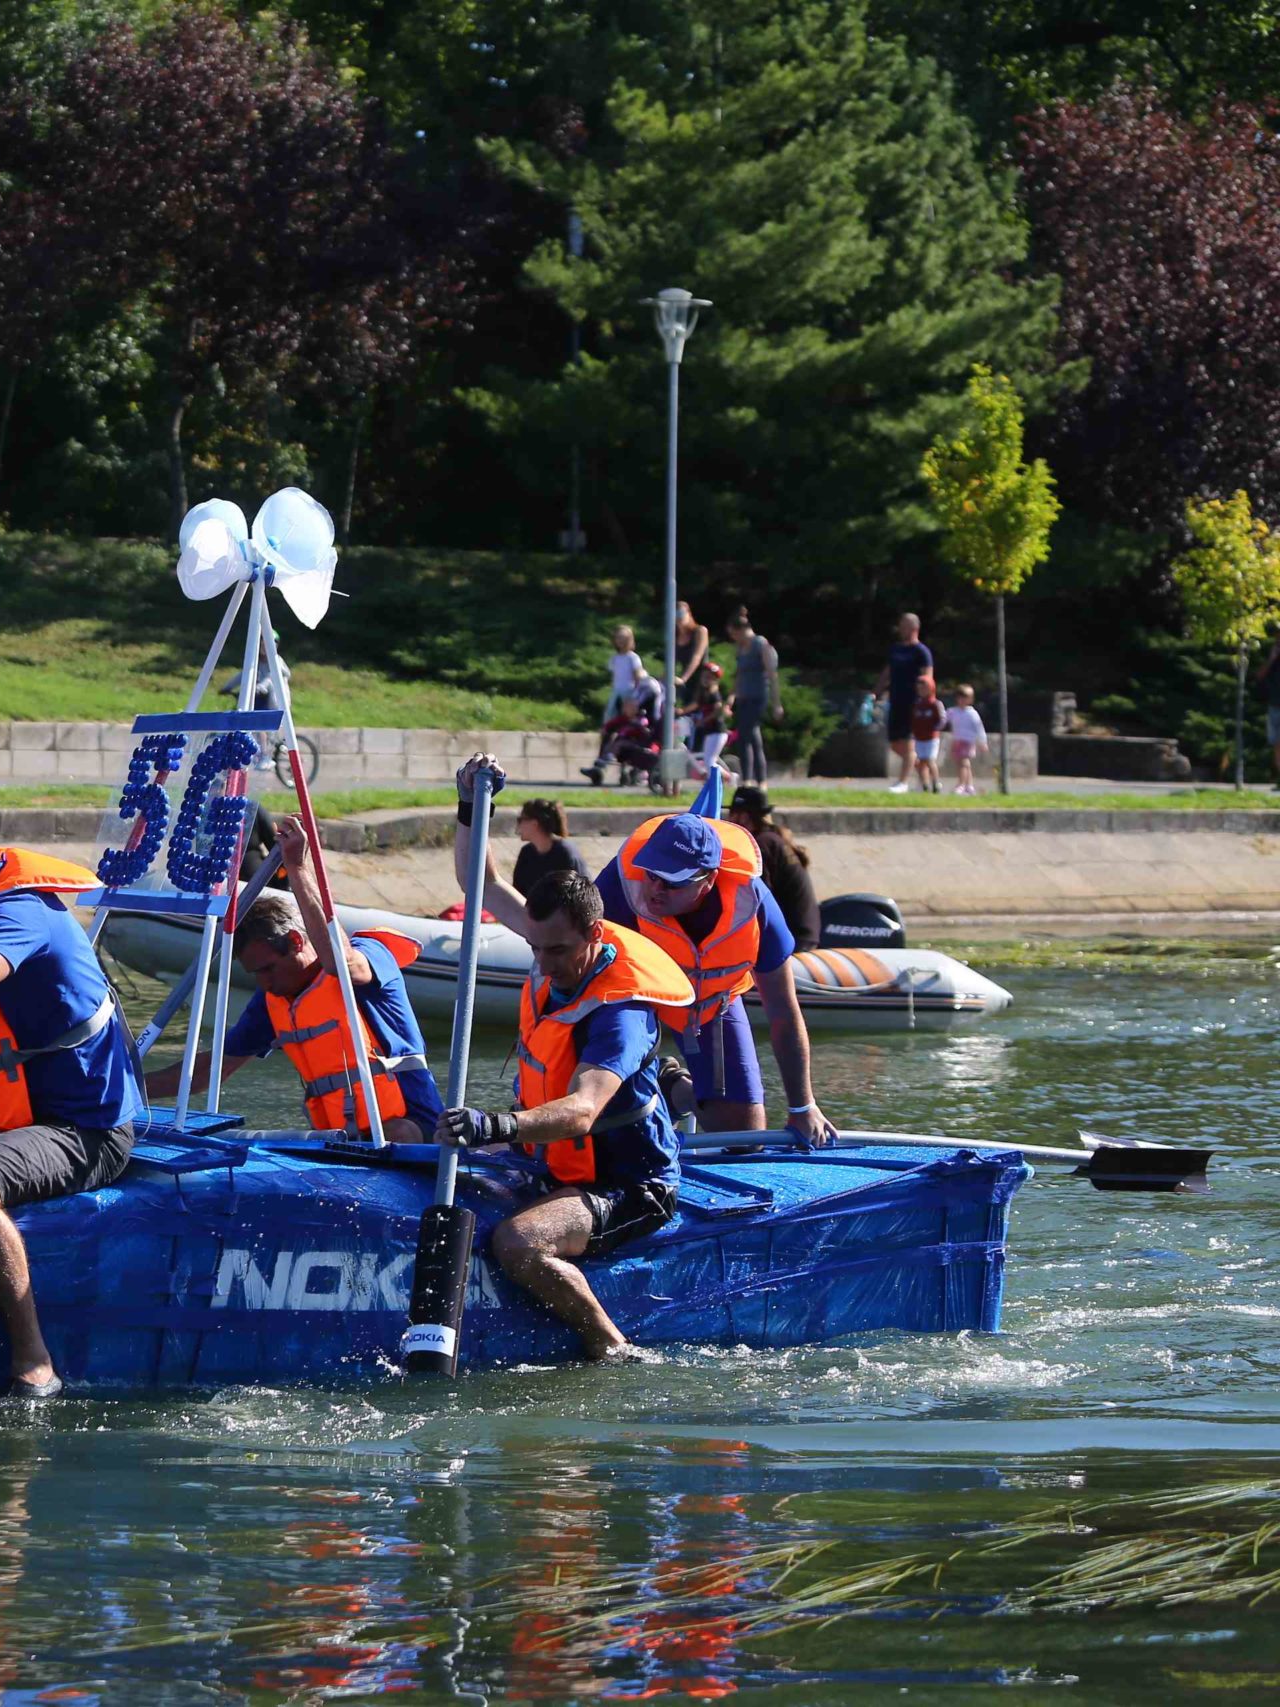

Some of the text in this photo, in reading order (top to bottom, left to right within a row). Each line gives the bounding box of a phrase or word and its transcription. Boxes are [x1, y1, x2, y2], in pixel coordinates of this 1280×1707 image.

[96, 731, 259, 893] 5G
[674, 841, 695, 854] NOKIA
[825, 924, 893, 937] MERCURY
[210, 1249, 501, 1312] NOKA
